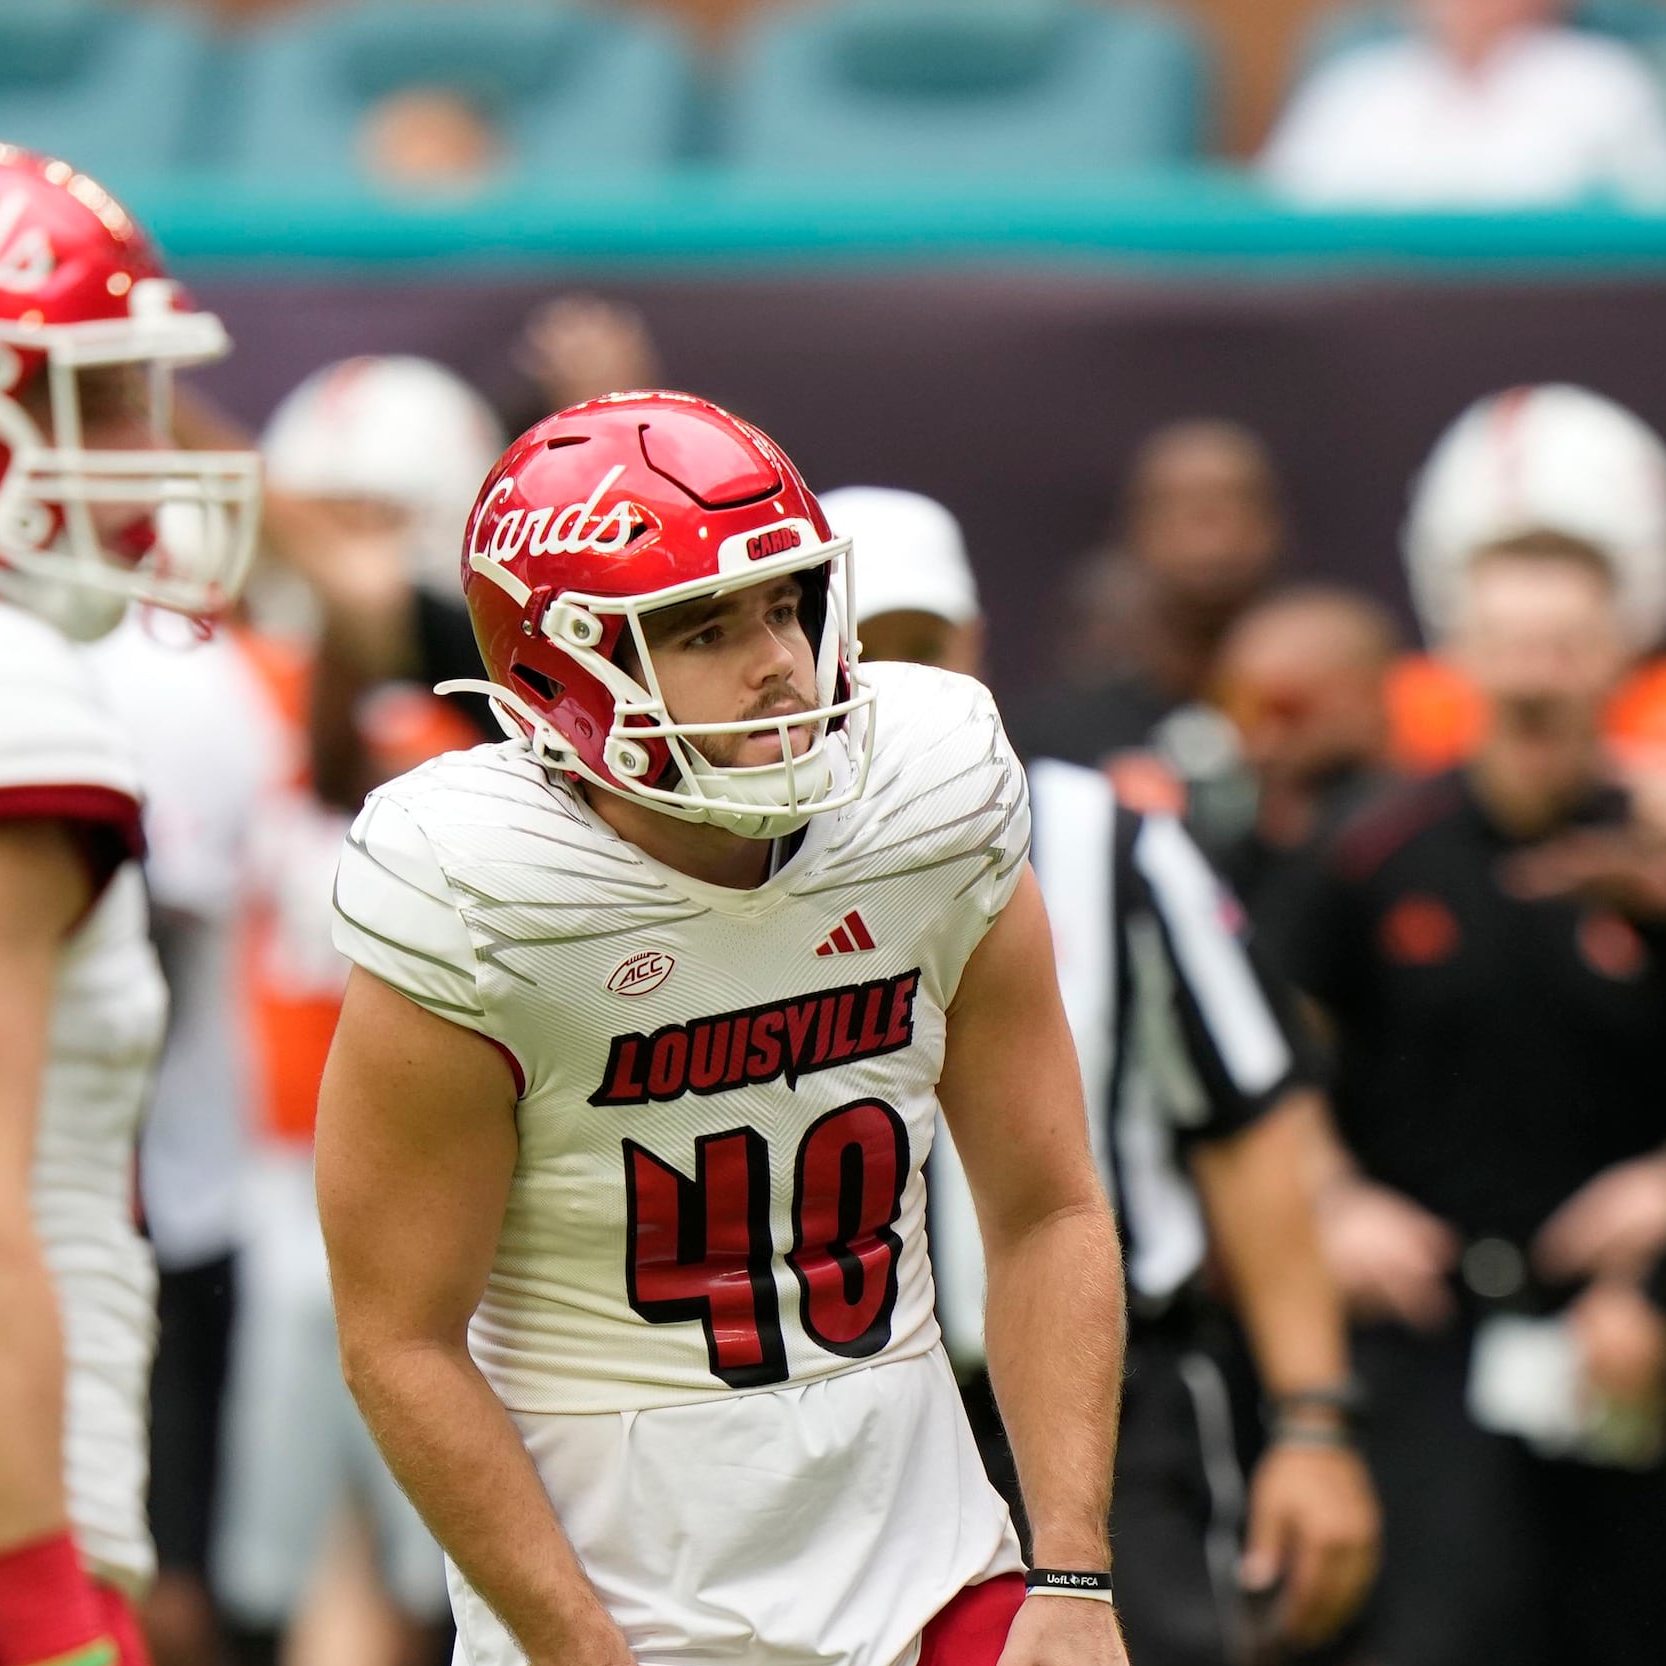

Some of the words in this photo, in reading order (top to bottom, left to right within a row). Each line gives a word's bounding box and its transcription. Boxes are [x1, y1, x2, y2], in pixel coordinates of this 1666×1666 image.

[470, 465, 632, 563] Cards
[746, 524, 801, 561] CARDS
[618, 961, 664, 988] ACC
[587, 967, 921, 1107] LOUISVILLE
[621, 1097, 910, 1389] 40
[1047, 1574, 1070, 1585] UofL
[1080, 1577, 1098, 1586] FCA
